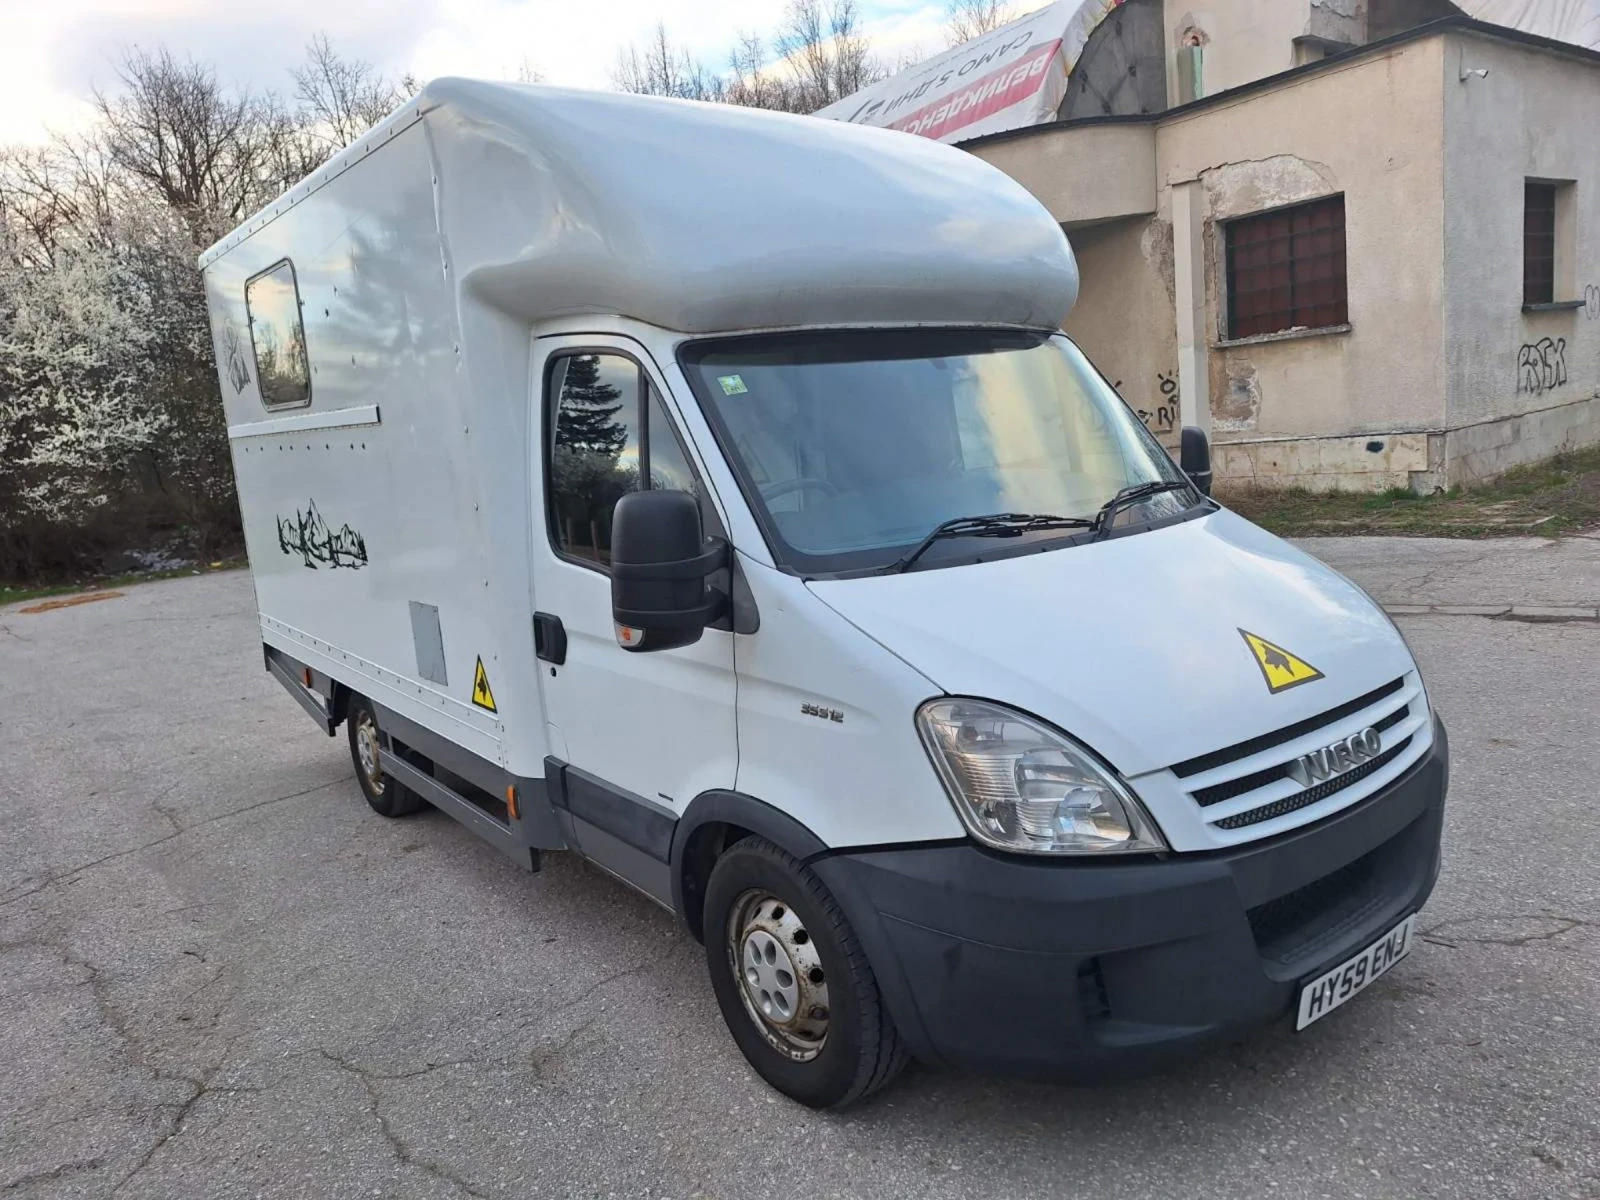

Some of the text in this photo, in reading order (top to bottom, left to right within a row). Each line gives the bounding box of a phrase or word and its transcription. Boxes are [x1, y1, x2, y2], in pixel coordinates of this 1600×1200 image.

[957, 31, 1033, 76] САМО
[882, 75, 939, 115] ДНИ
[935, 69, 956, 88] 5
[1294, 727, 1381, 788] IVECO
[1308, 923, 1409, 1019] HY59 ENJ
